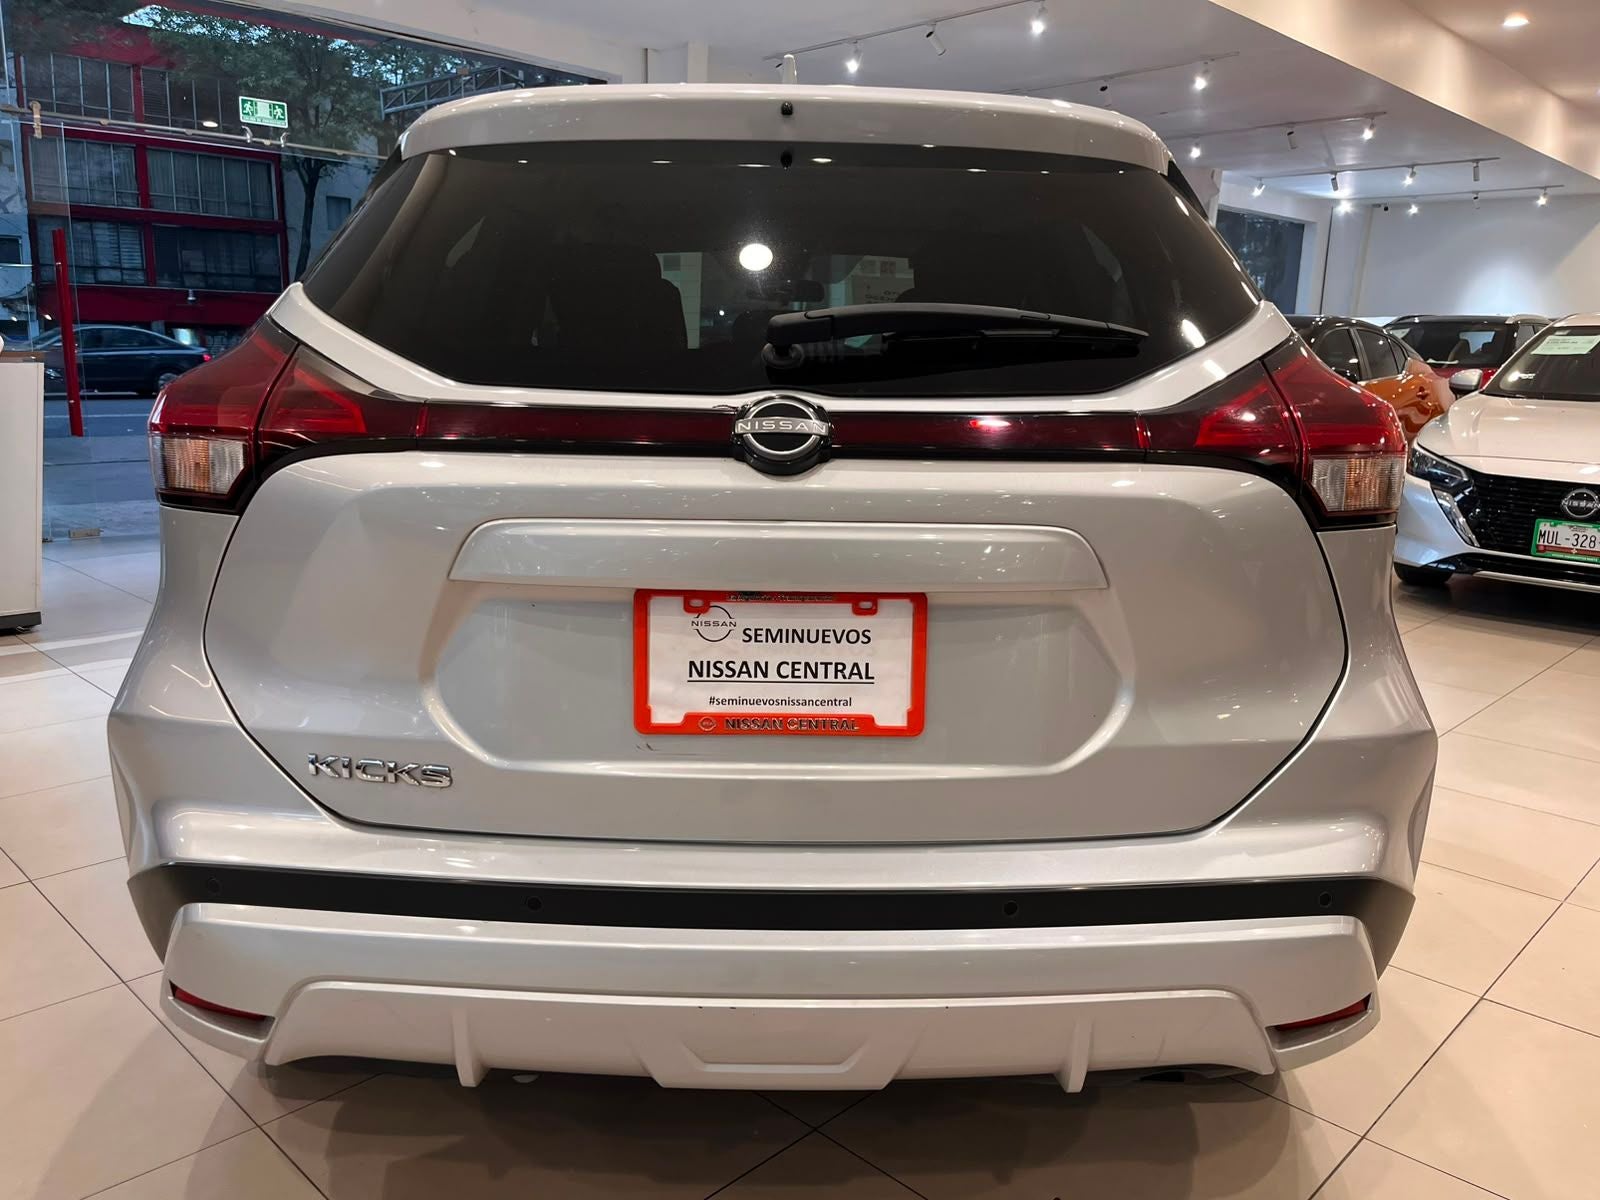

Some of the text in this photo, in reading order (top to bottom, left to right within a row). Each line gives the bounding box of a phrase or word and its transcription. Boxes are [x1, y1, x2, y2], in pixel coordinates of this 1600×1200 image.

[737, 420, 826, 433] NISSAN
[1538, 529, 1600, 549] MUL-328
[691, 620, 737, 628] NISSAN
[742, 627, 872, 645] SEMINUEVOS
[688, 660, 875, 680] NISSAN CENTRAL
[709, 695, 852, 707] #seminuevosnissancentral
[725, 718, 783, 730] NISSAN
[787, 718, 860, 731] CENTRAL
[307, 752, 453, 788] KICKS
